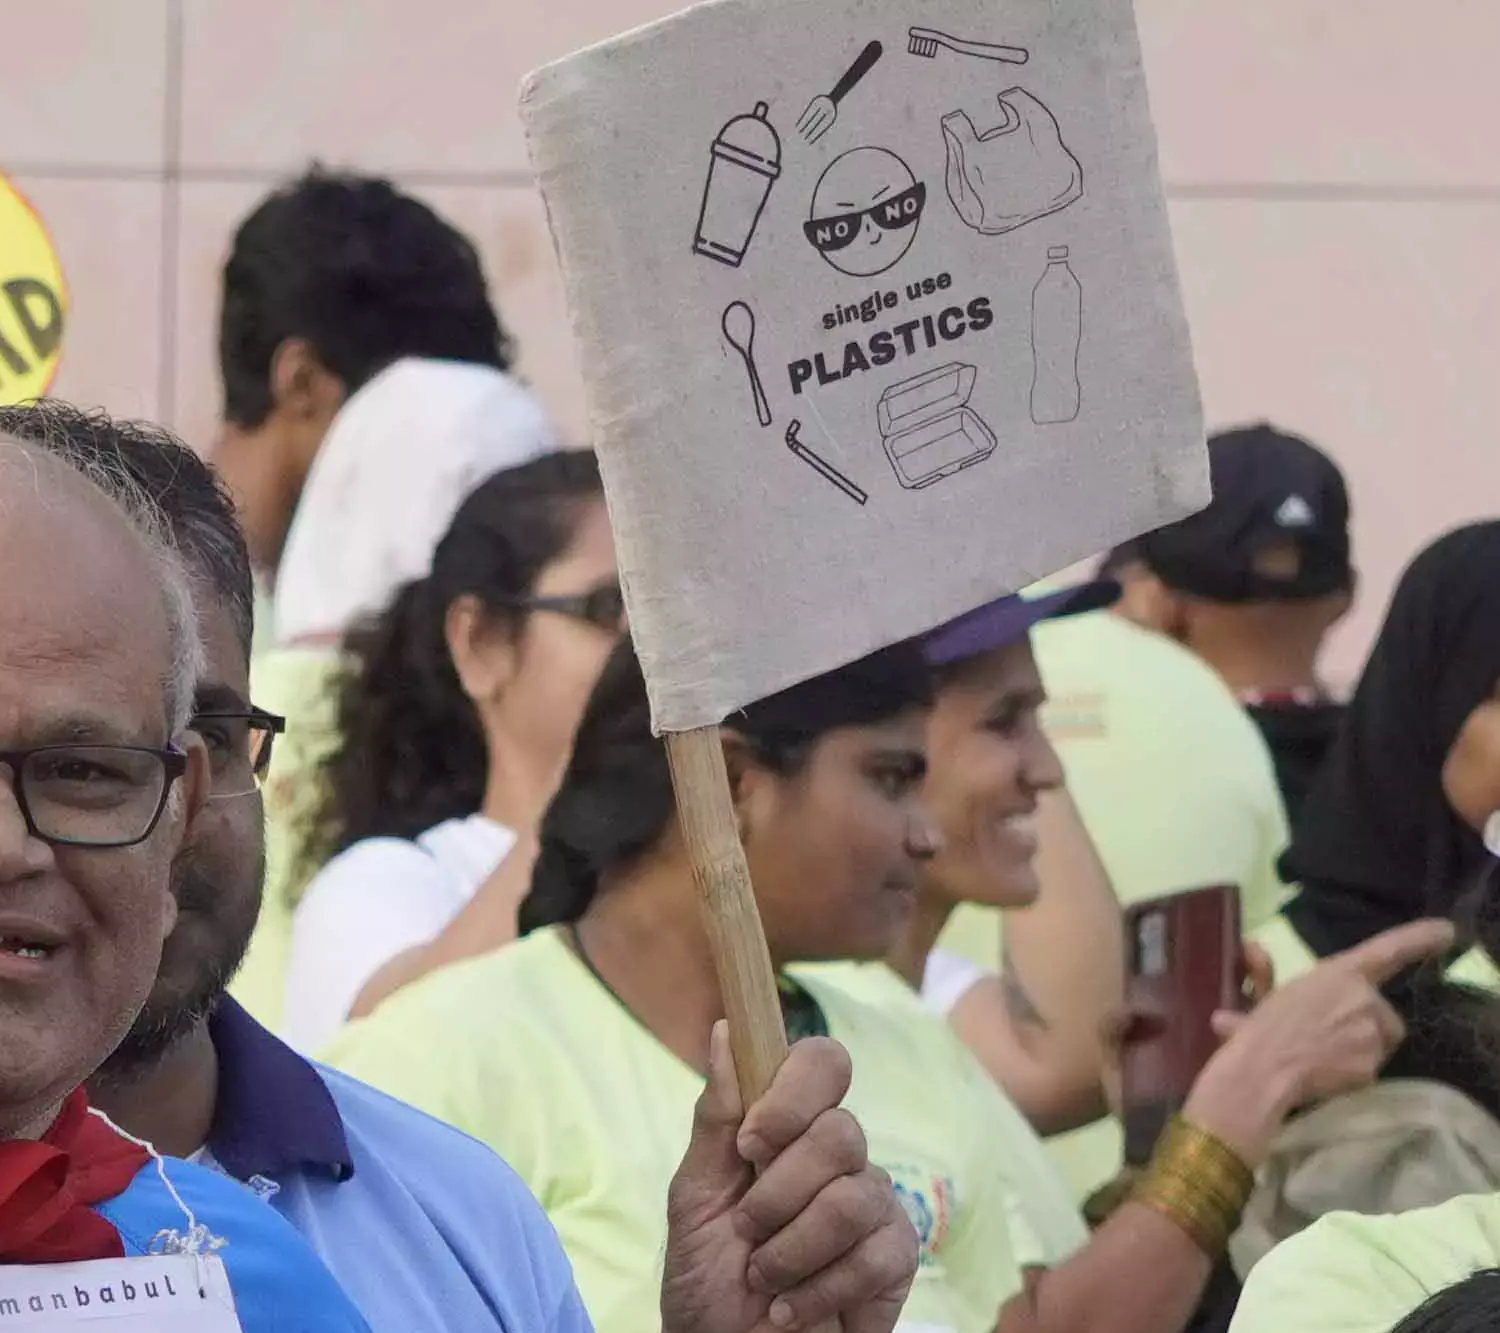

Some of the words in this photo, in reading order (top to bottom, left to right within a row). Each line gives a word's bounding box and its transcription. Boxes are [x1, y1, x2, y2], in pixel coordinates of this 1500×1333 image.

[815, 221, 850, 244] NO
[884, 196, 917, 220] NO
[821, 287, 898, 332] single
[905, 271, 953, 306] use
[787, 297, 994, 394] PLASTICS
